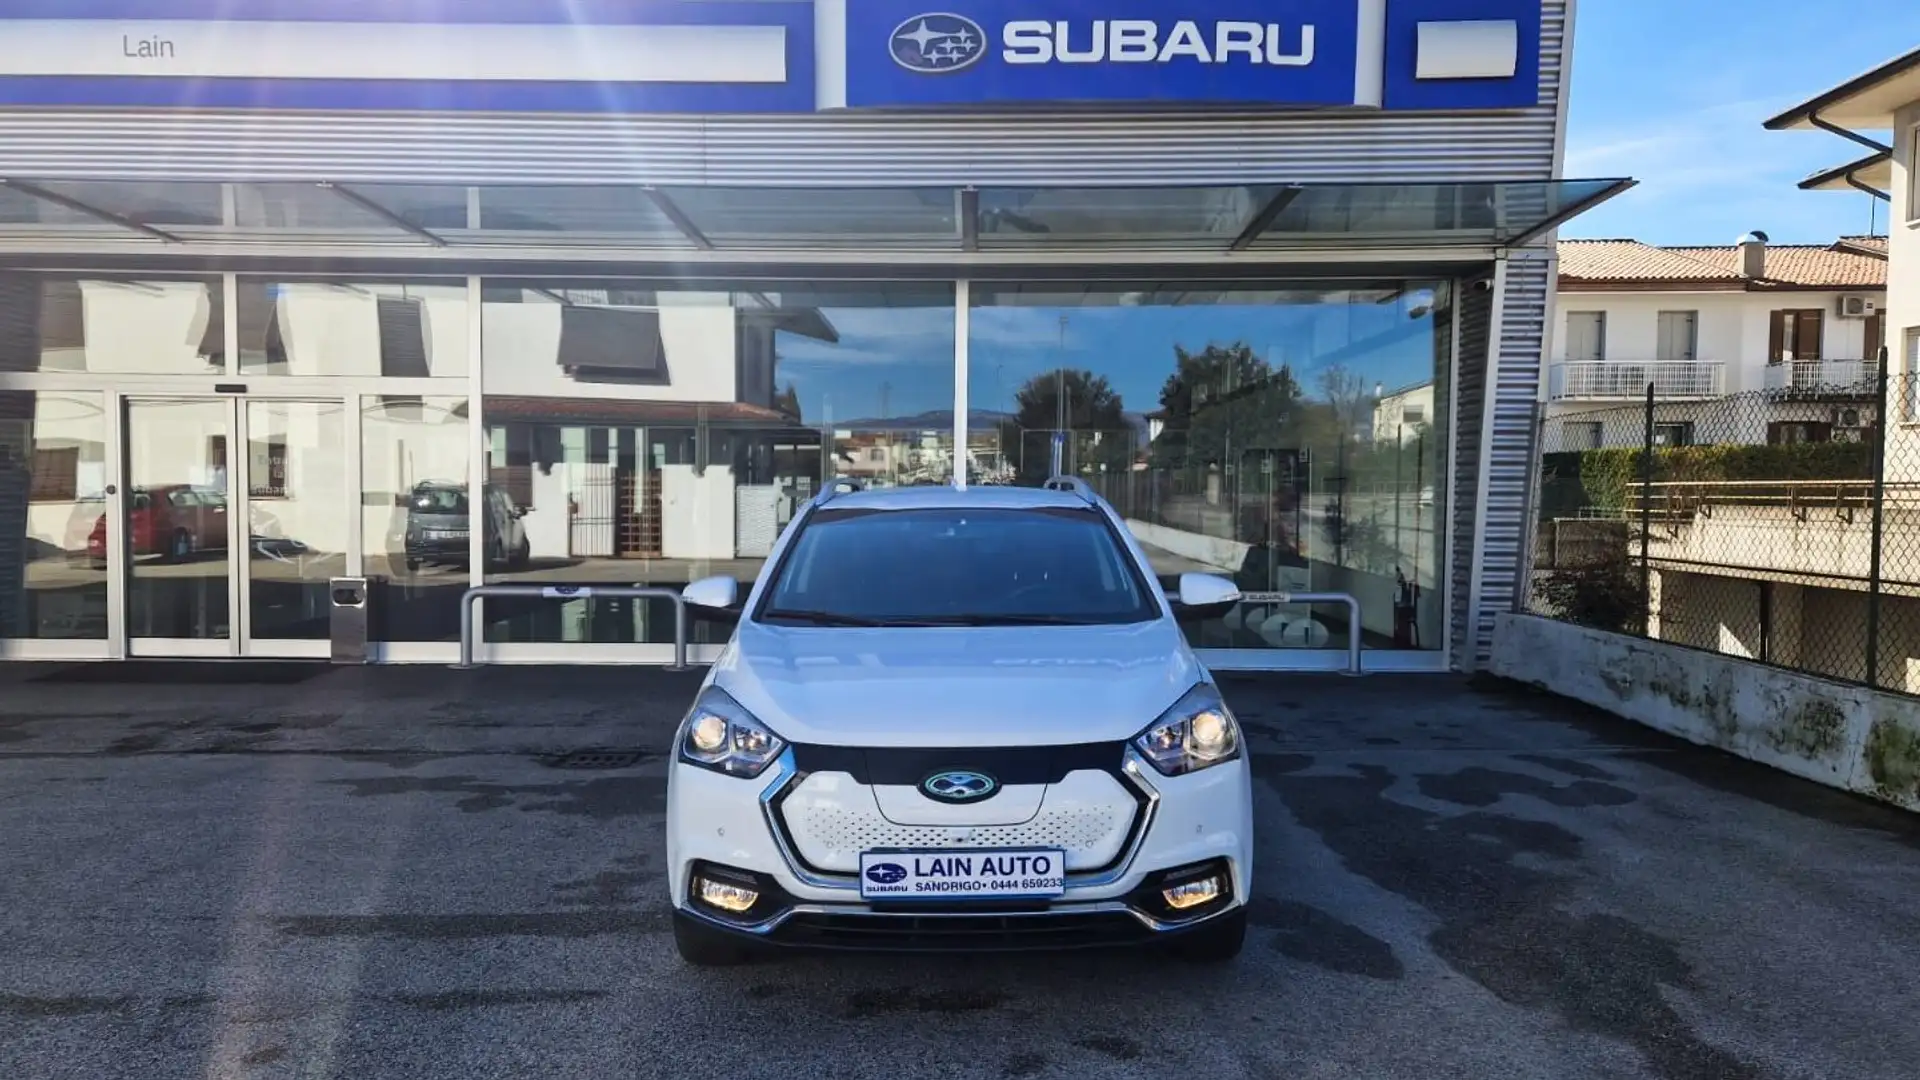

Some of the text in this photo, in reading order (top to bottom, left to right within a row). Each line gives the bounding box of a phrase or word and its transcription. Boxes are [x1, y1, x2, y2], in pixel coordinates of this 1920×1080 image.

[123, 34, 175, 58] Lain
[1002, 19, 1315, 66] SUBARU
[914, 856, 1051, 877] LAIN AUTO
[990, 879, 1019, 890] 0444
[1022, 878, 1063, 889] 659233
